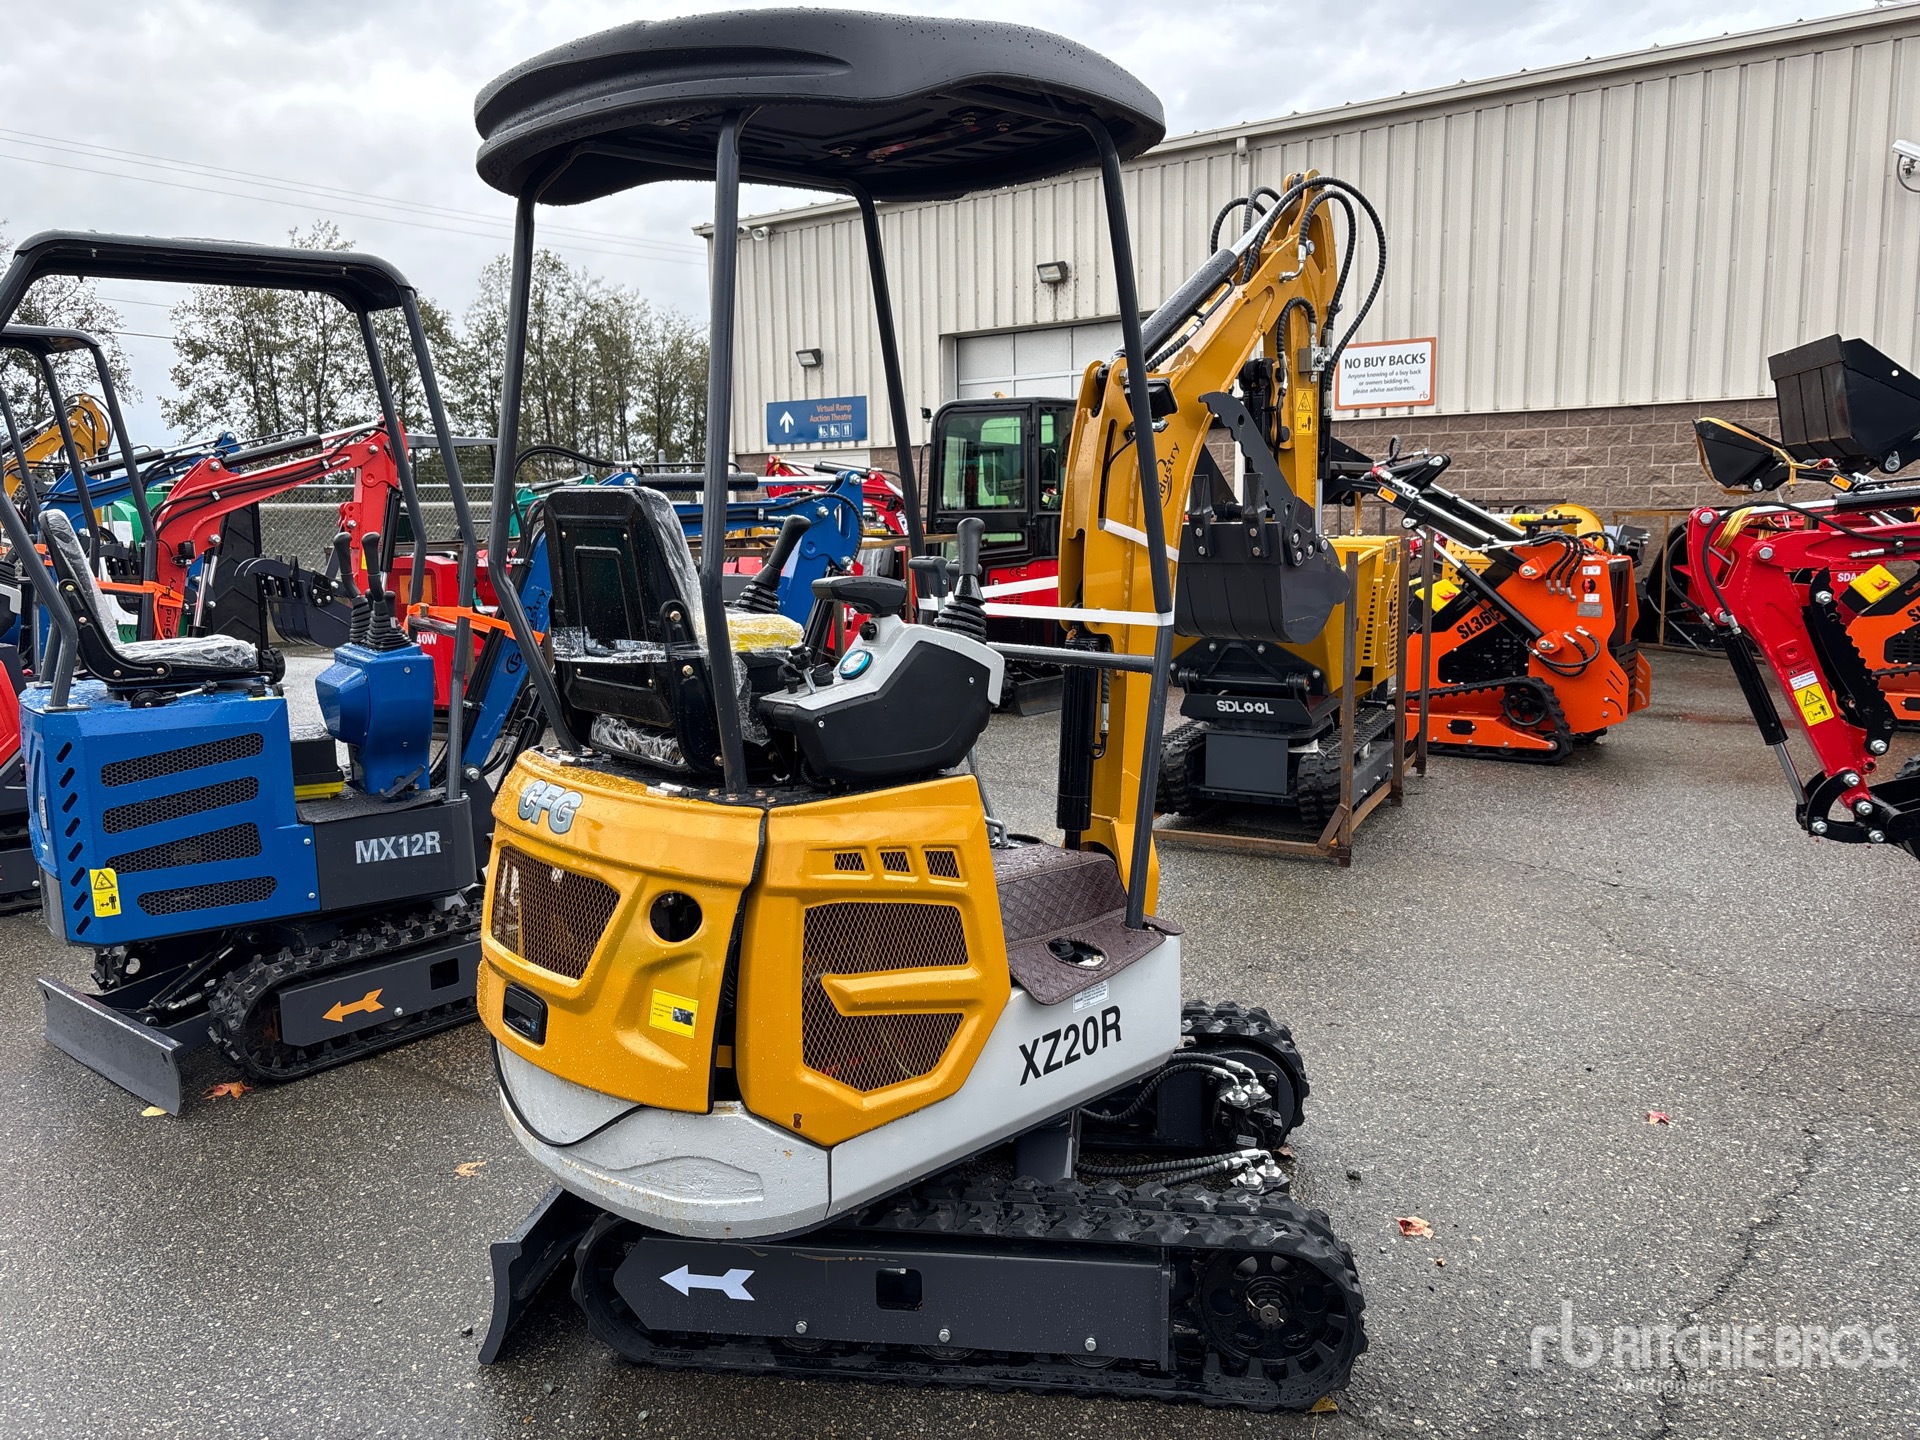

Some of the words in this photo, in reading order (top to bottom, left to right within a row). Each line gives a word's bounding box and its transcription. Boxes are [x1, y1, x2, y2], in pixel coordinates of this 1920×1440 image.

[1344, 358, 1361, 369] NO
[1364, 356, 1386, 368] BUY
[1389, 353, 1426, 366] BACKS
[1419, 390, 1428, 399] rb
[816, 404, 834, 412] Virtual
[836, 404, 852, 412] Ramp
[810, 414, 830, 422] Auction
[1216, 699, 1275, 715] SDLOOL
[517, 778, 584, 835] CFG
[355, 830, 442, 864] MX12R
[1018, 1005, 1122, 1087] XZ20R
